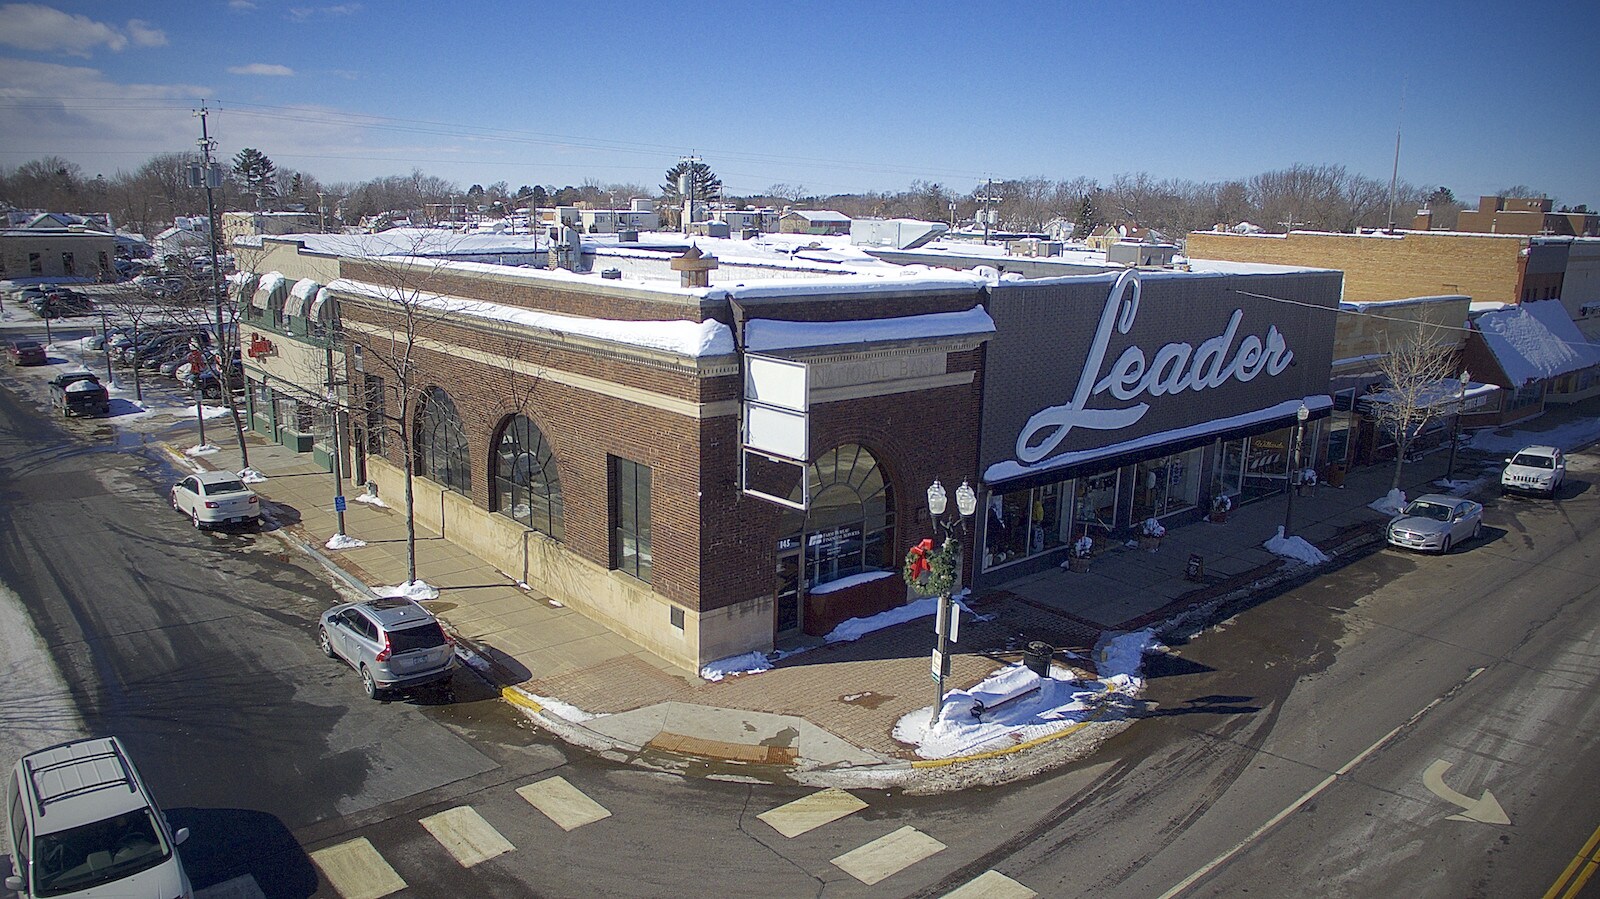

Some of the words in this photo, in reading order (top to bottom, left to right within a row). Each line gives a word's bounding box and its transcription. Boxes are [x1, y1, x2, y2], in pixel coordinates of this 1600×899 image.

[814, 361, 890, 386] NATIONAL
[900, 357, 939, 377] BANK
[1015, 268, 1295, 463] Leader
[780, 538, 791, 549] 145
